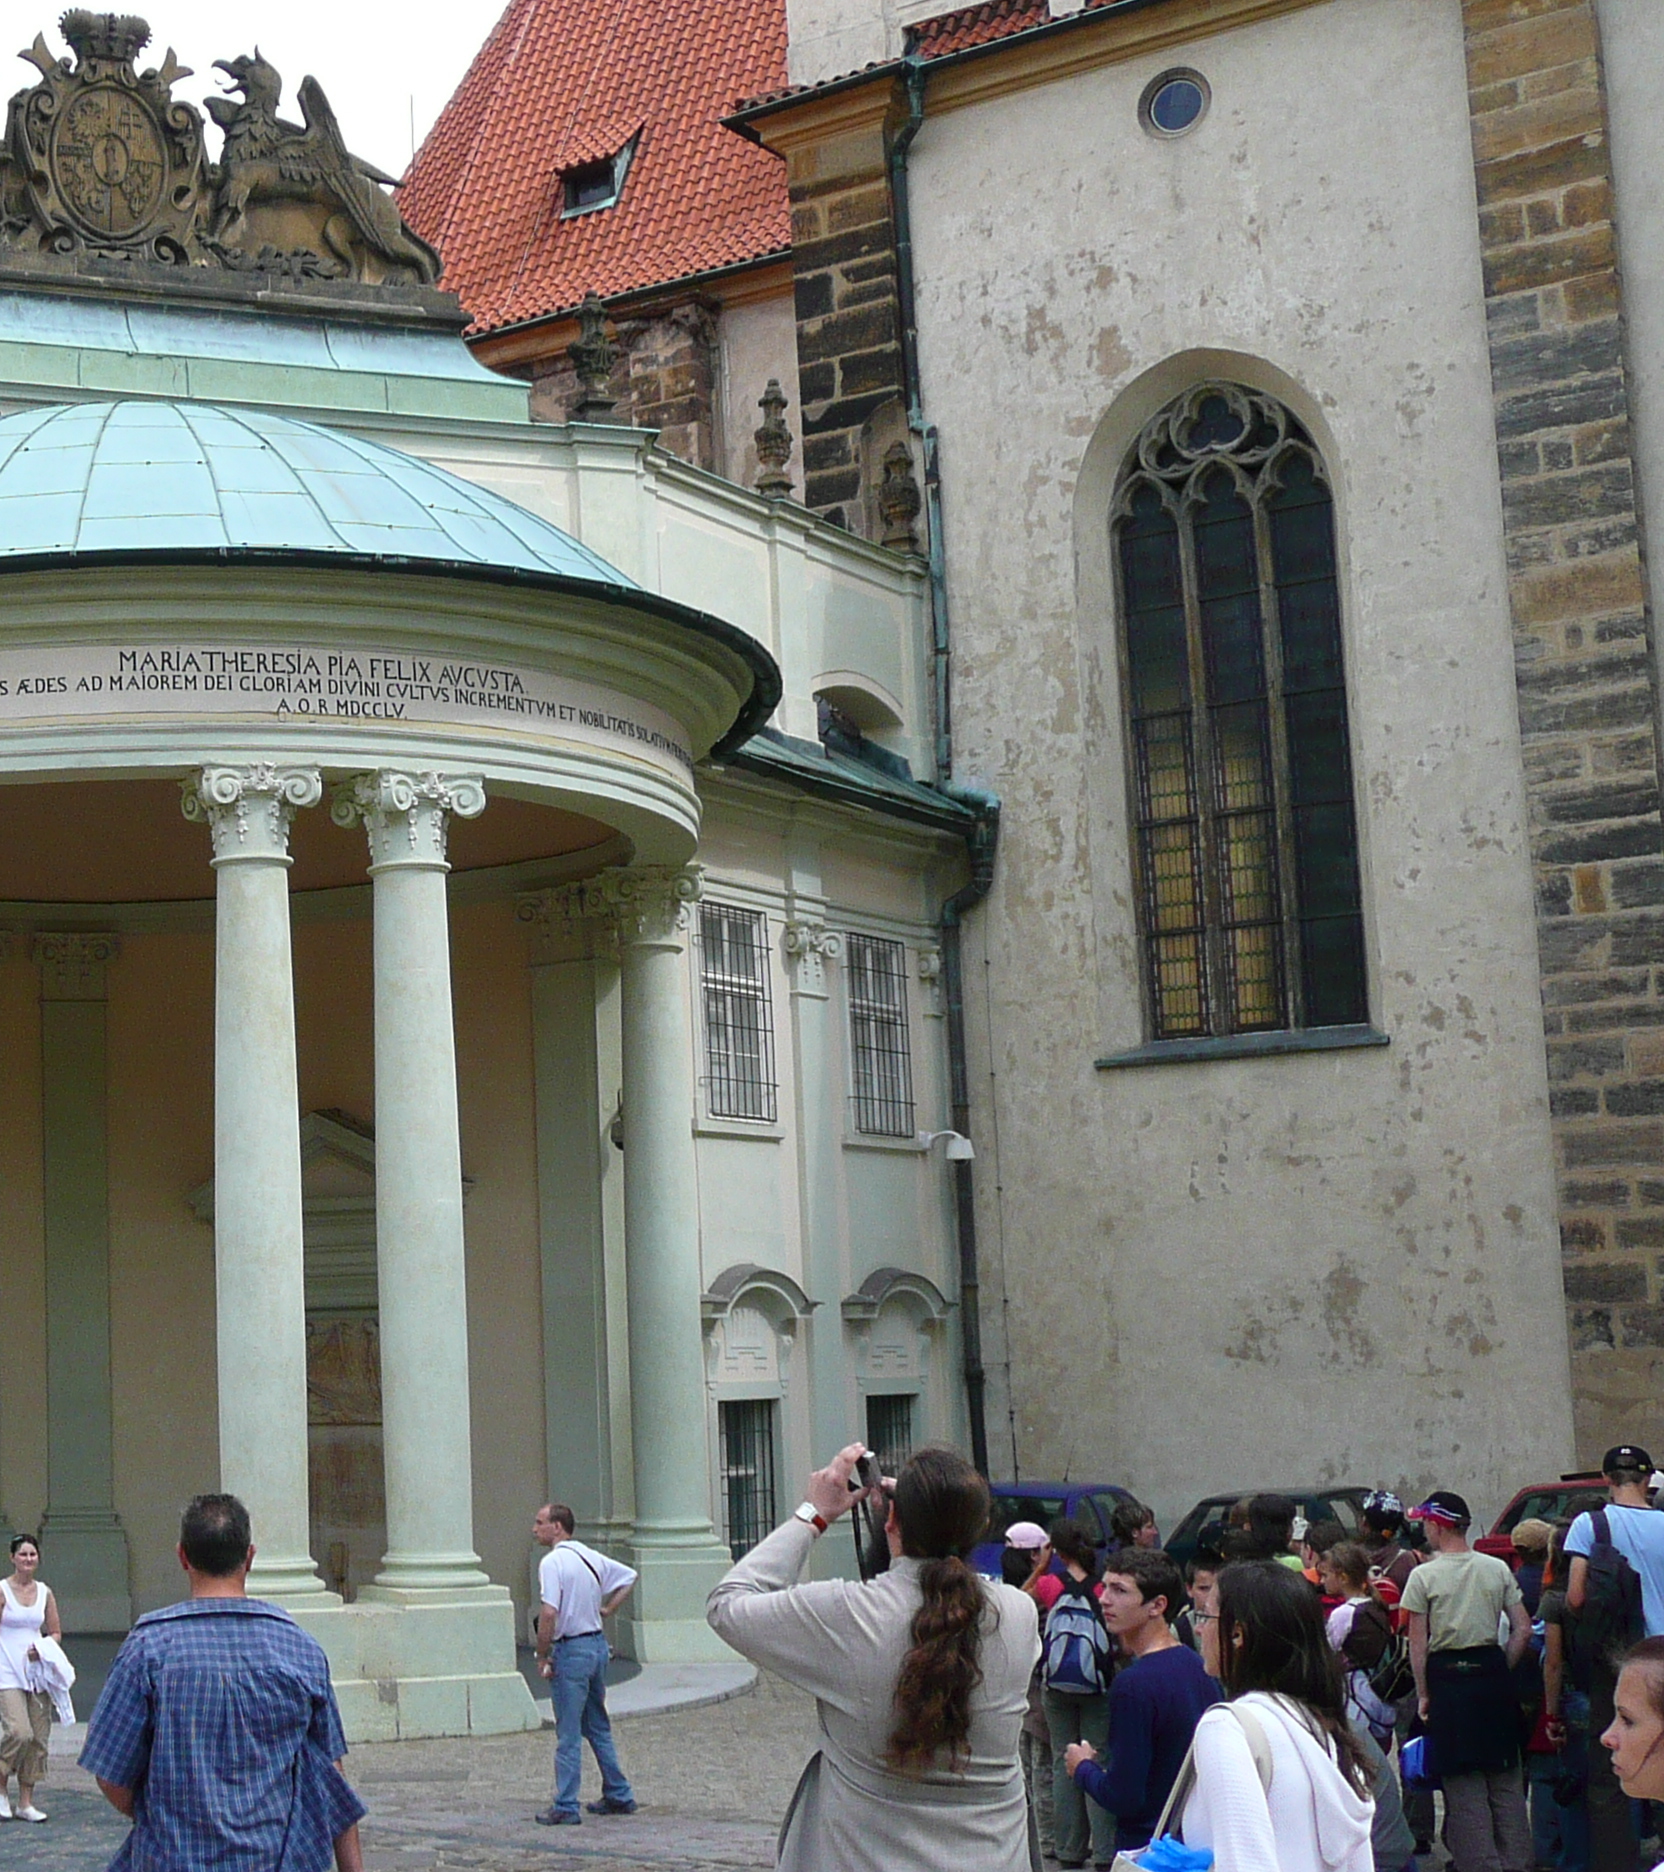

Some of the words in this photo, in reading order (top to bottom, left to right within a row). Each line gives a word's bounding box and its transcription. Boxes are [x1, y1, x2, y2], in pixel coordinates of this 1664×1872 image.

[328, 651, 361, 677] PIA
[369, 656, 432, 683] FELIX
[76, 675, 103, 693] AD
[109, 671, 197, 692] MAIOREM
[204, 672, 233, 691] DEI
[328, 676, 380, 698] DIVINI
[386, 683, 450, 703] CVLTVS
[454, 686, 556, 718] INCREMENTVM
[559, 705, 576, 722] ET
